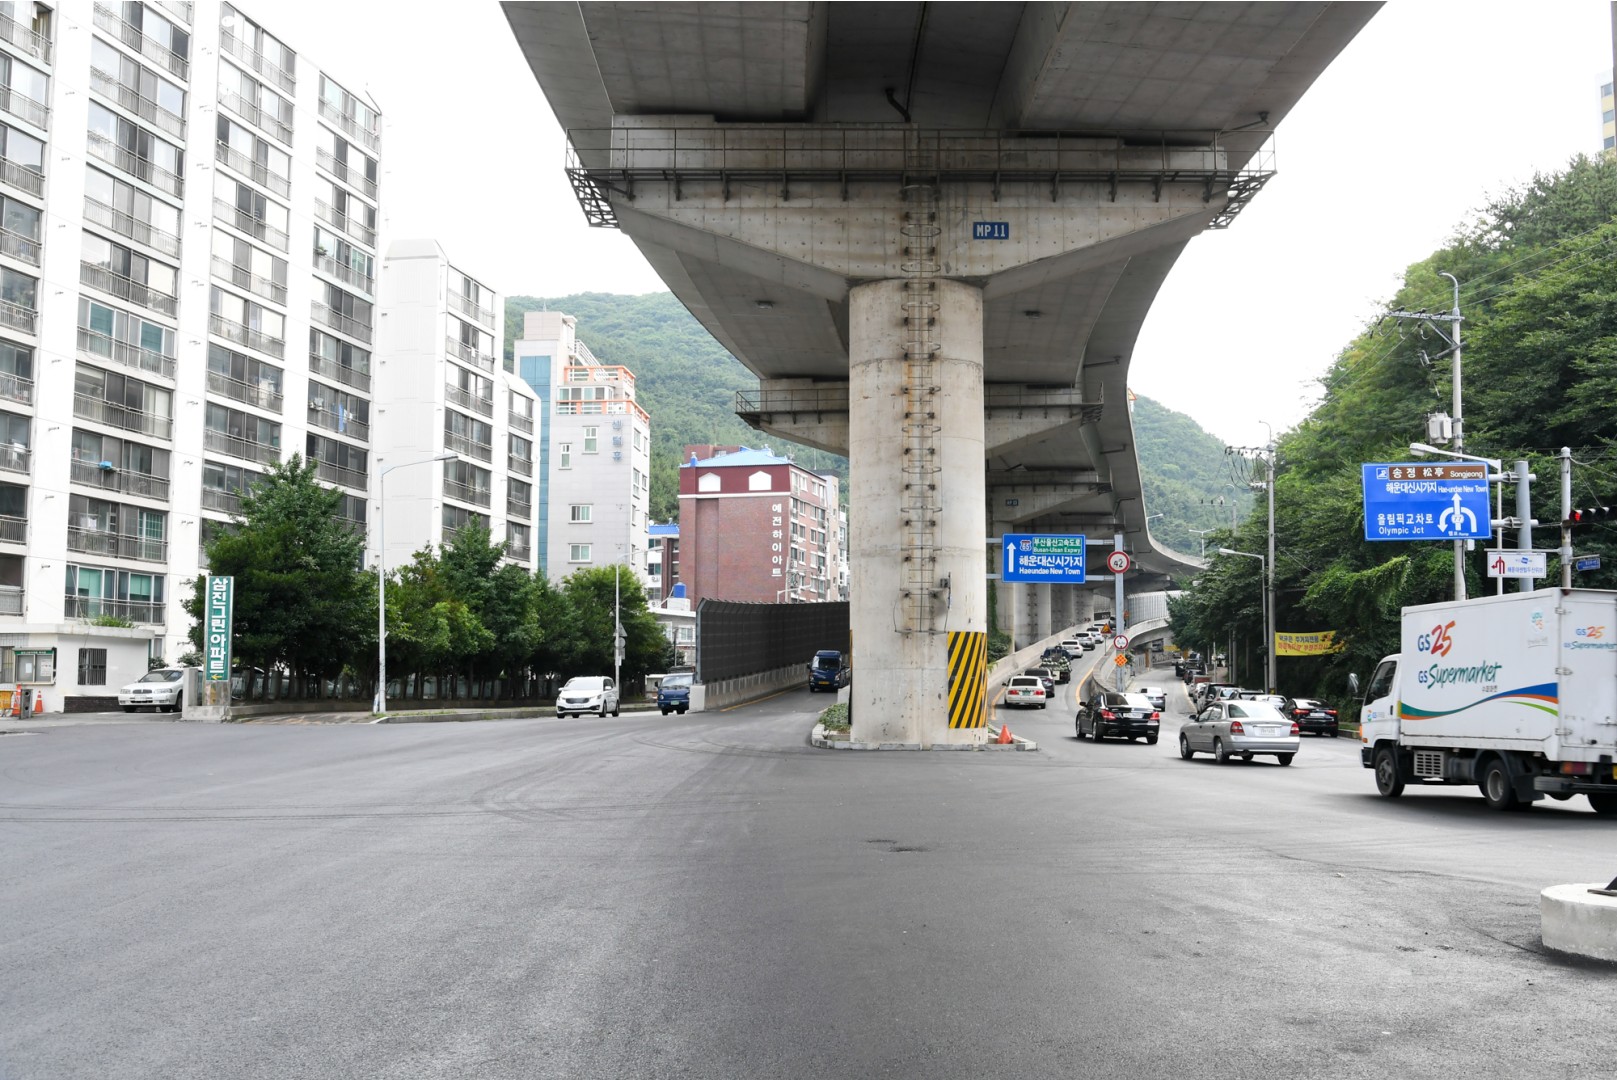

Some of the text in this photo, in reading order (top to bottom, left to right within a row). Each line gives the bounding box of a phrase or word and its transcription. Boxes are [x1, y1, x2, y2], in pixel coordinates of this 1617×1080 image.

[976, 224, 1006, 237] MP 11
[1450, 470, 1483, 479] Songjeong
[1386, 482, 1437, 494] 해운대신시가지
[1463, 485, 1474, 493] New
[1475, 485, 1488, 493] Town
[1377, 513, 1434, 526] 올림픽교차로
[1378, 526, 1424, 536] Olympic Jct
[1019, 555, 1083, 567] 해운대신시가지
[1019, 567, 1081, 575] Haeundae New Town
[209, 577, 229, 674] 삼진그린아파트
[1575, 625, 1605, 639] GS25
[1417, 620, 1456, 657] GS25
[1418, 660, 1502, 690] GS Supermarket
